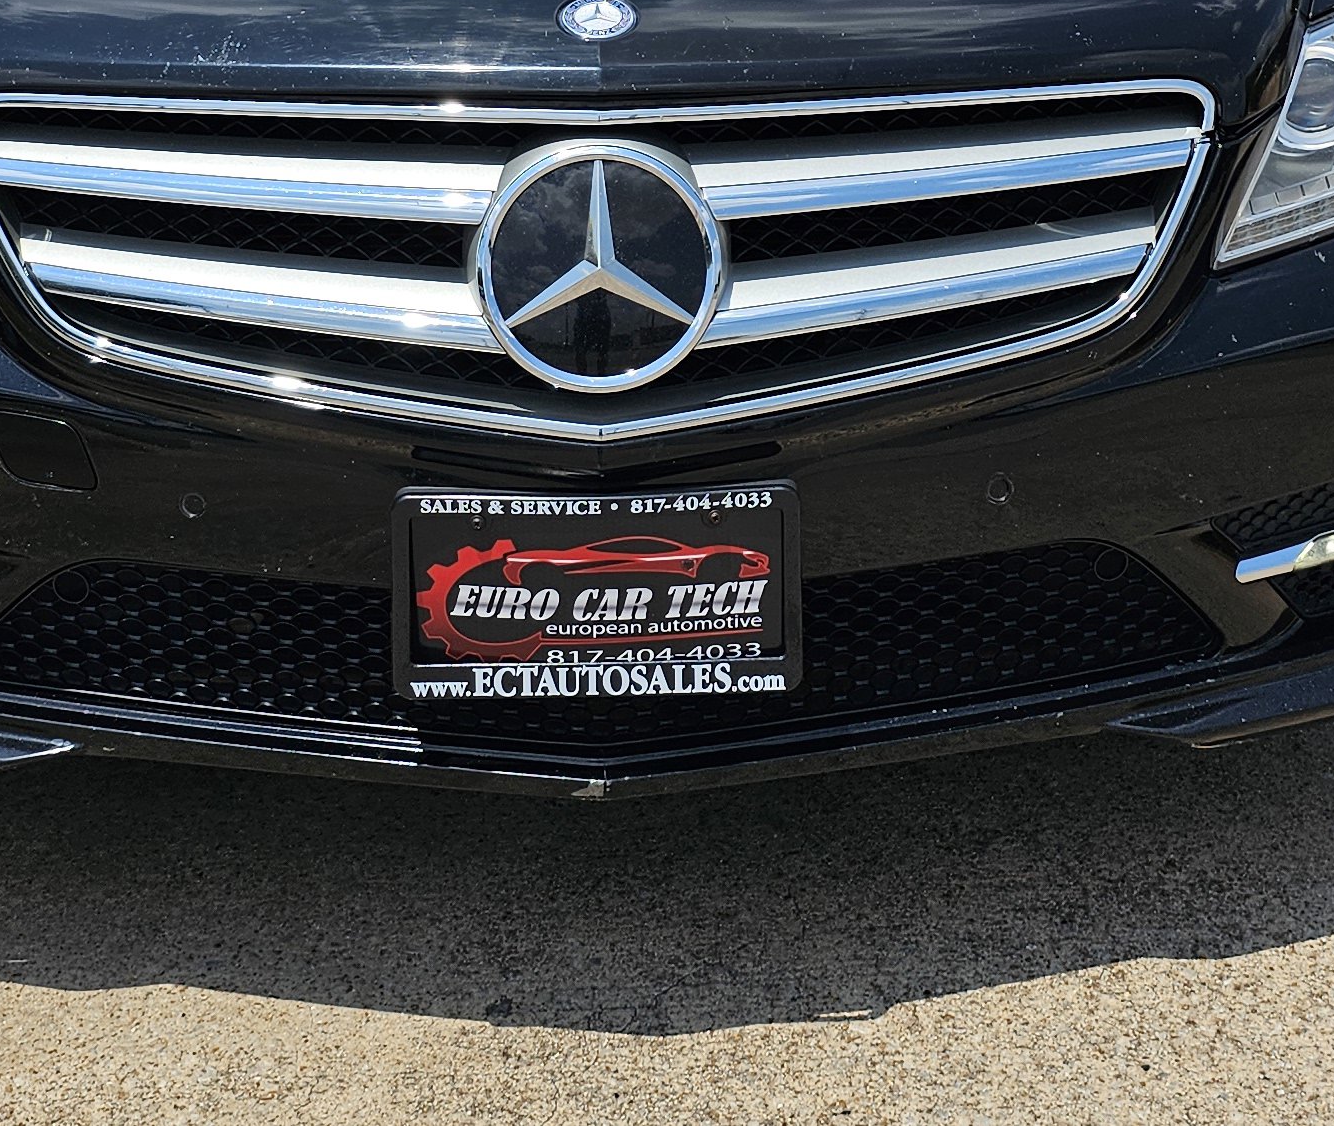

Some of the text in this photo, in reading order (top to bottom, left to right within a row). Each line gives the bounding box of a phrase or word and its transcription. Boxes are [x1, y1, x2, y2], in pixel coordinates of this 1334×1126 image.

[420, 491, 772, 515] SALES & SERVICE 817-404-4033
[450, 580, 769, 621] EURO CAR TECH
[545, 613, 763, 639] european automotive
[546, 642, 761, 665] 817-404-4033
[410, 663, 787, 698] www.ECTAUTOSALES.com
